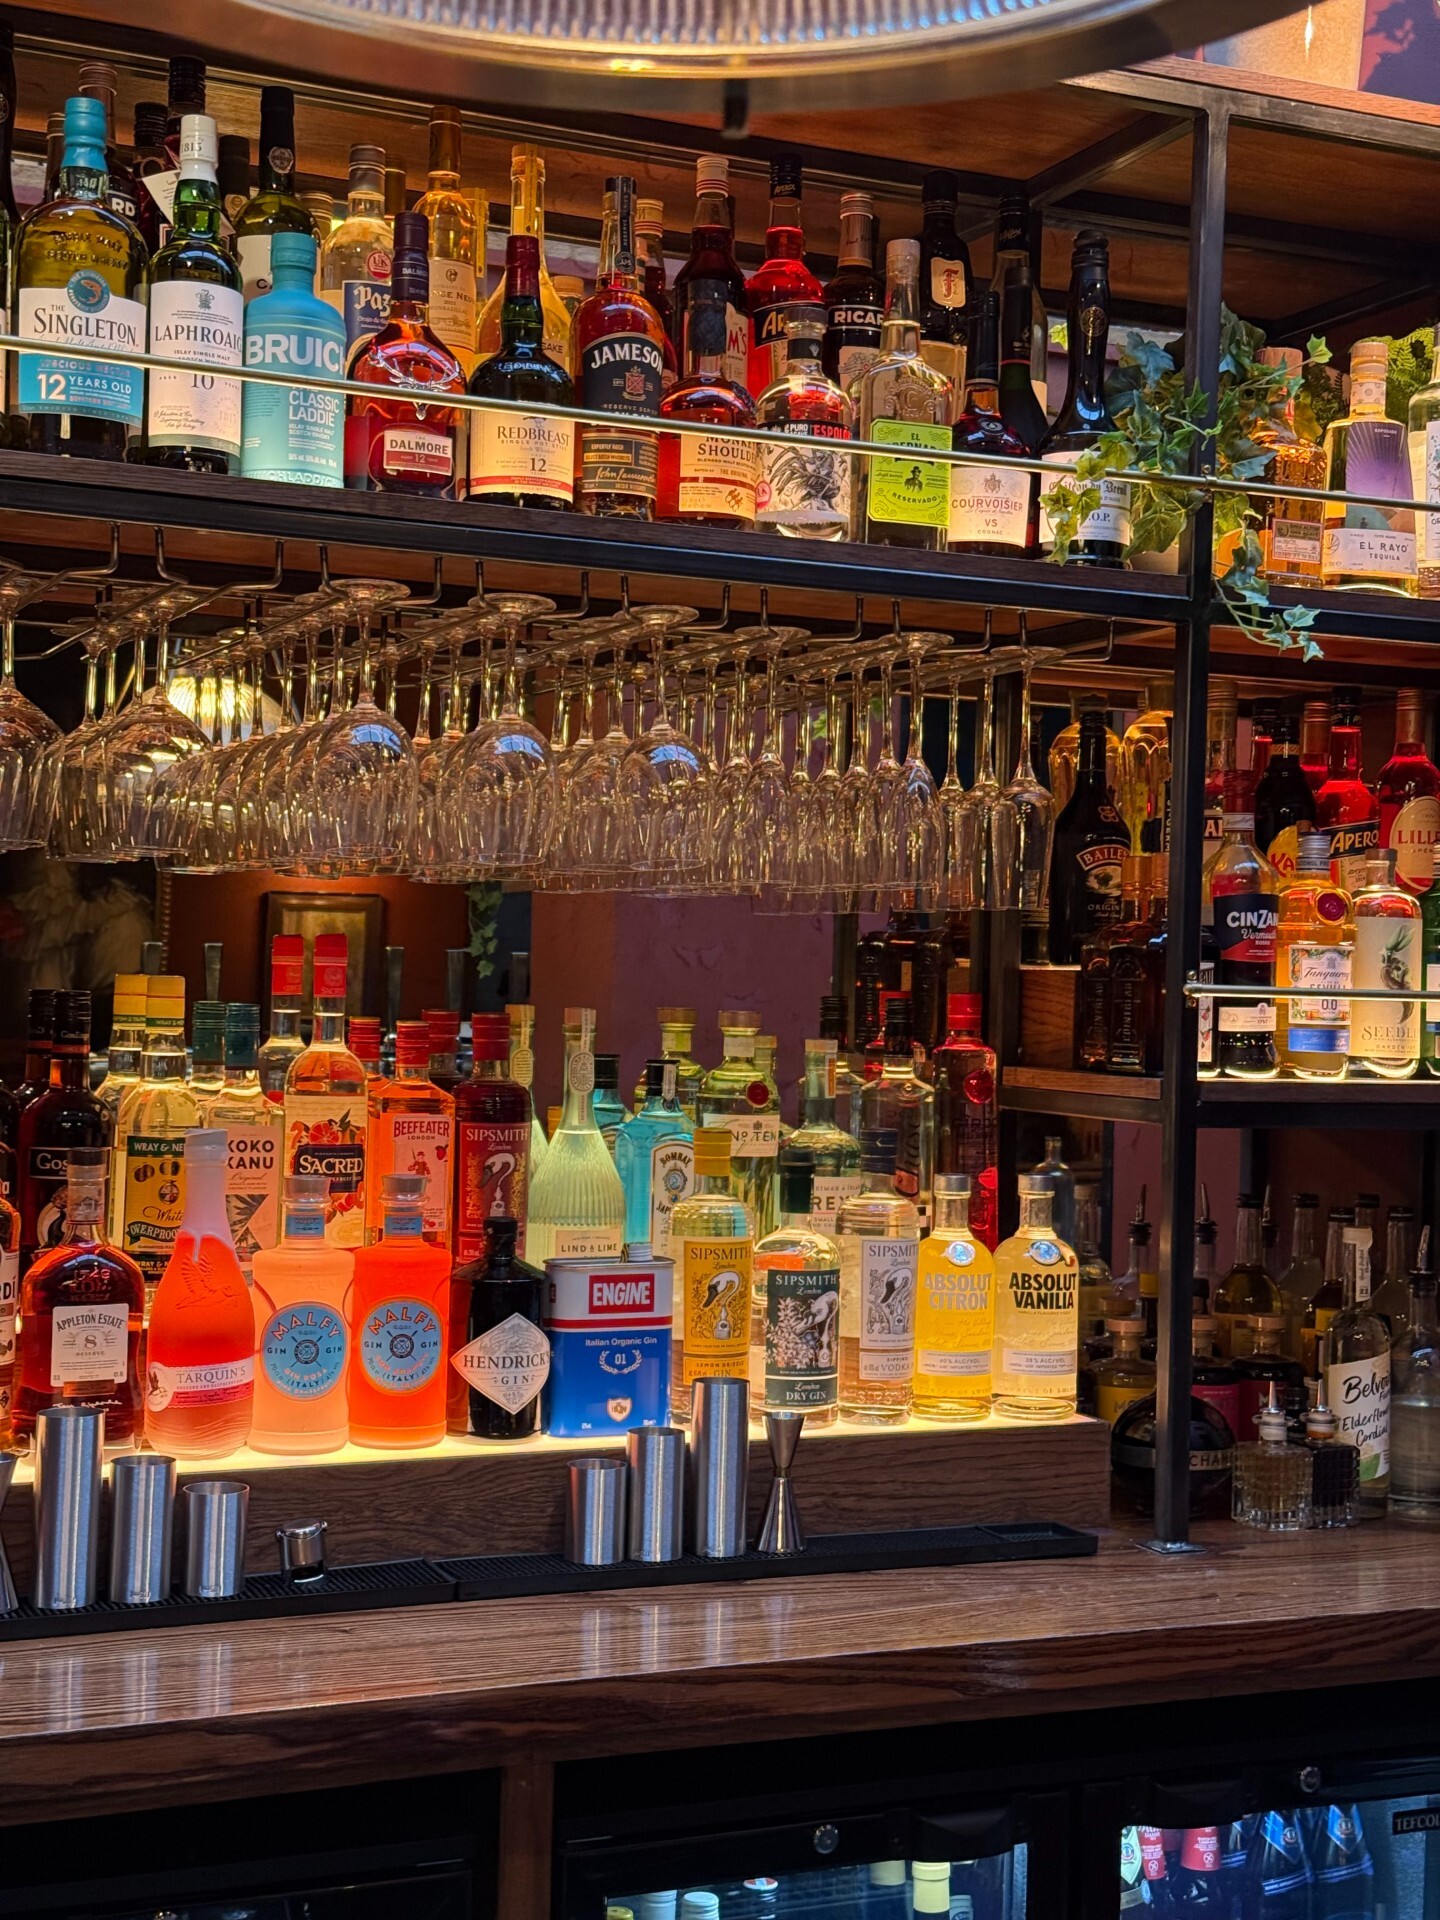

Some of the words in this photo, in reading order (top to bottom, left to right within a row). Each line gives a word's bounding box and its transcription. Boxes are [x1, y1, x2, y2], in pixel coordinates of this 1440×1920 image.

[50, 304, 66, 312] THE
[34, 308, 138, 346] SINGLETON
[216, 353, 231, 361] MALT
[590, 343, 664, 376] JAMESON
[37, 374, 66, 400] 12
[68, 375, 108, 389] YEARS
[111, 382, 132, 394] OLD
[191, 373, 215, 391] 10
[289, 391, 340, 413] CLASSIC
[289, 405, 336, 428] LADDIE
[790, 424, 809, 433] PURO
[497, 425, 571, 447] REDBREAST
[911, 433, 921, 441] EL
[389, 438, 449, 455] DALMORE
[414, 454, 426, 464] 12
[529, 457, 547, 473] 12
[892, 492, 938, 504] RESERVADO
[951, 498, 1024, 513] COURVOISIER
[984, 519, 998, 528] VS
[1359, 542, 1372, 550] EL
[1380, 542, 1407, 553] RAYO
[1369, 553, 1401, 561] TEQUILA
[393, 1121, 450, 1138] BEEFEATER
[466, 1128, 528, 1141] SIPSMITH
[134, 1143, 158, 1152] WRAY
[160, 1143, 169, 1151] &
[488, 1142, 512, 1151] London
[299, 1155, 363, 1174] SACRED
[659, 1152, 693, 1168] BOMBAY
[143, 1206, 184, 1222] White
[590, 1244, 595, 1252] &
[598, 1243, 617, 1252] LIME
[691, 1247, 751, 1261] SIPSMITH
[712, 1262, 737, 1270] London
[890, 1257, 911, 1267] London
[775, 1274, 837, 1286] SIPSMITH
[924, 1272, 992, 1292] ABSOLUT
[1009, 1271, 1077, 1292] ABSOLUT
[592, 1280, 651, 1307] ENGINE
[796, 1287, 822, 1295] London
[929, 1292, 988, 1310] CITRON
[1013, 1291, 1074, 1310] VANILIA
[56, 1313, 97, 1332] APPLETON
[98, 1313, 125, 1329] ESTATE
[271, 1311, 341, 1341] MALFY
[368, 1306, 437, 1336] MALFY
[84, 1335, 97, 1349] 8
[364, 1340, 382, 1349] GIN
[420, 1340, 438, 1349] GIN
[585, 1338, 609, 1347] Italian
[611, 1337, 642, 1348] Organic
[643, 1337, 657, 1345] Gin
[267, 1347, 287, 1355] GIN
[326, 1346, 342, 1354] GIN
[614, 1353, 626, 1365] 01
[284, 1367, 300, 1380] GIN
[881, 1363, 911, 1372] VODKA
[501, 1375, 529, 1385] GIN
[794, 1381, 821, 1391] London
[786, 1391, 807, 1401] DRY
[808, 1390, 826, 1400] GIN
[1356, 1420, 1388, 1447] Cordial
